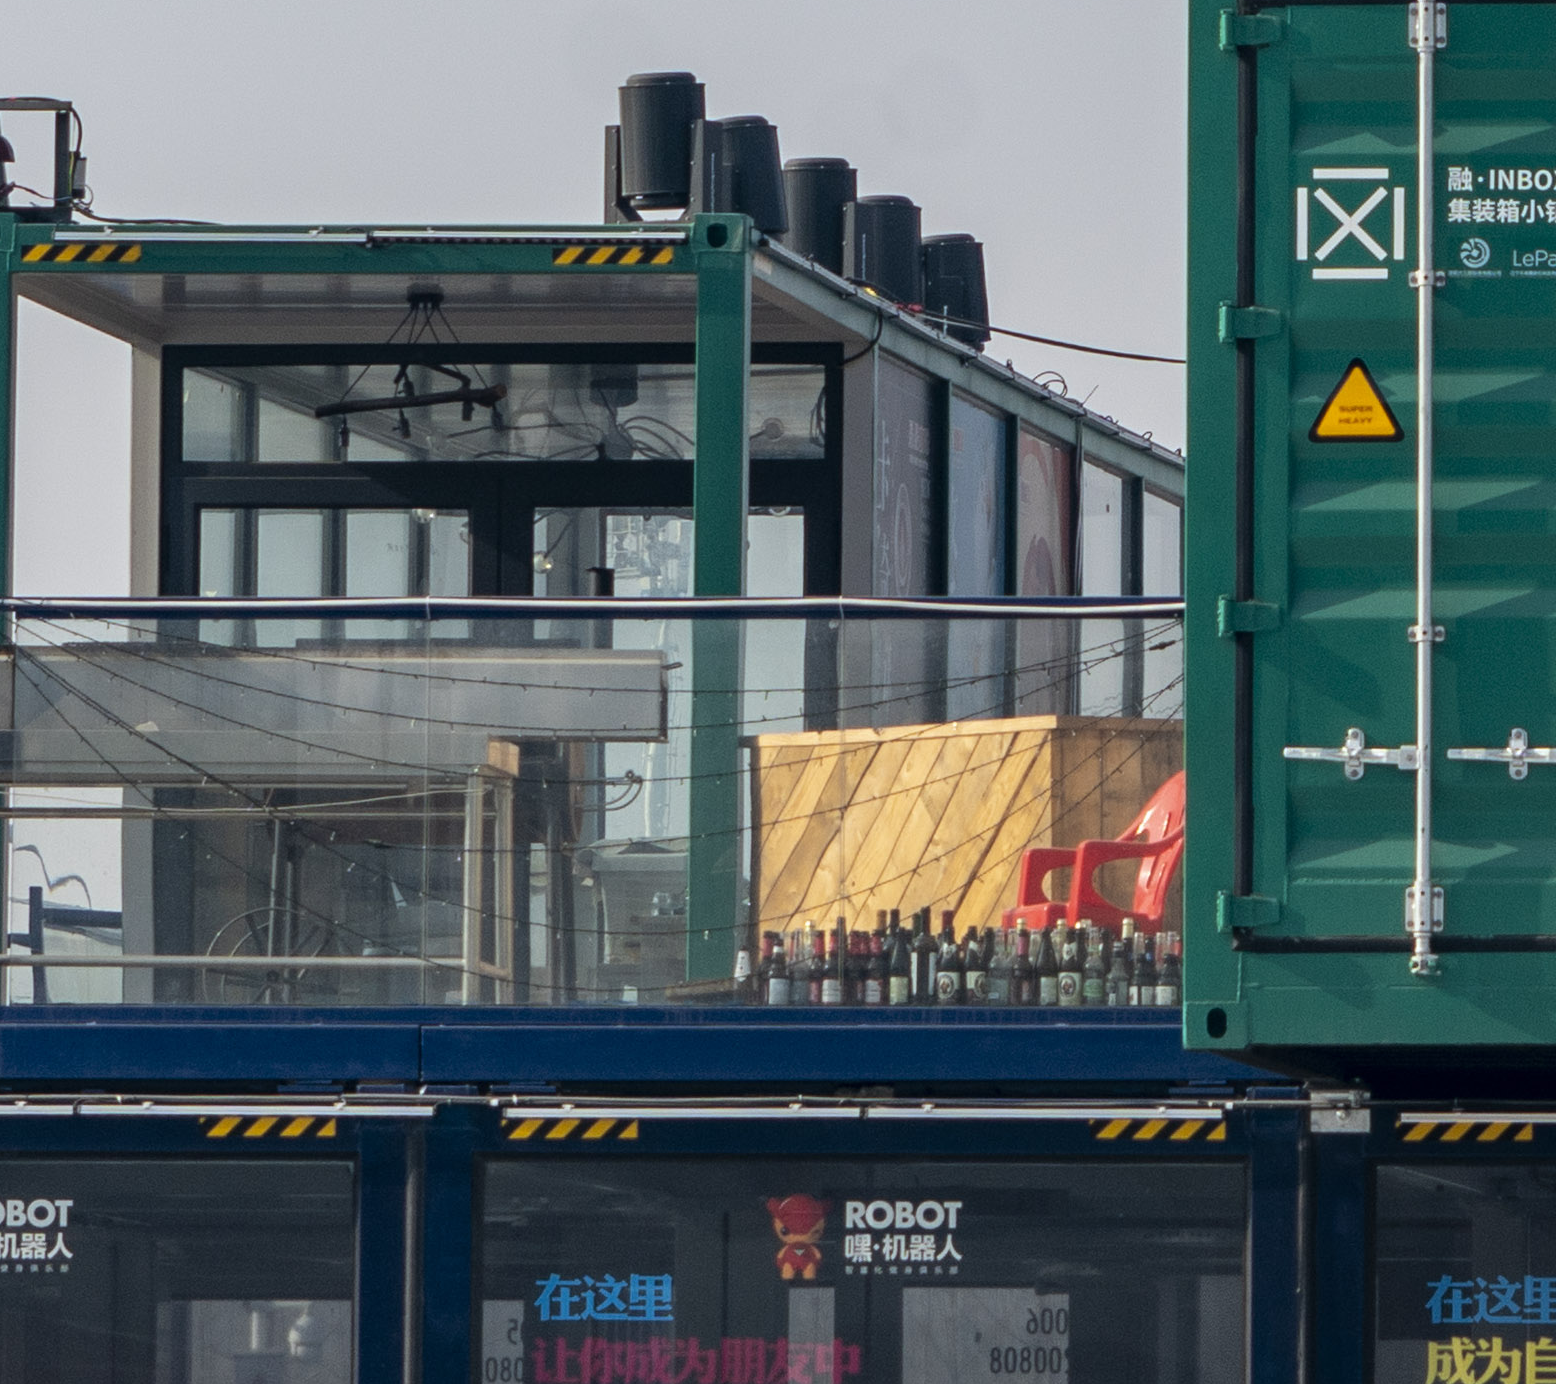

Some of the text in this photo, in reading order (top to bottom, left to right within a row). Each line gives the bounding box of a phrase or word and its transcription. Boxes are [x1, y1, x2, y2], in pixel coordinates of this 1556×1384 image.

[845, 1201, 962, 1229] ROBOT
[533, 1273, 673, 1321] 在这里
